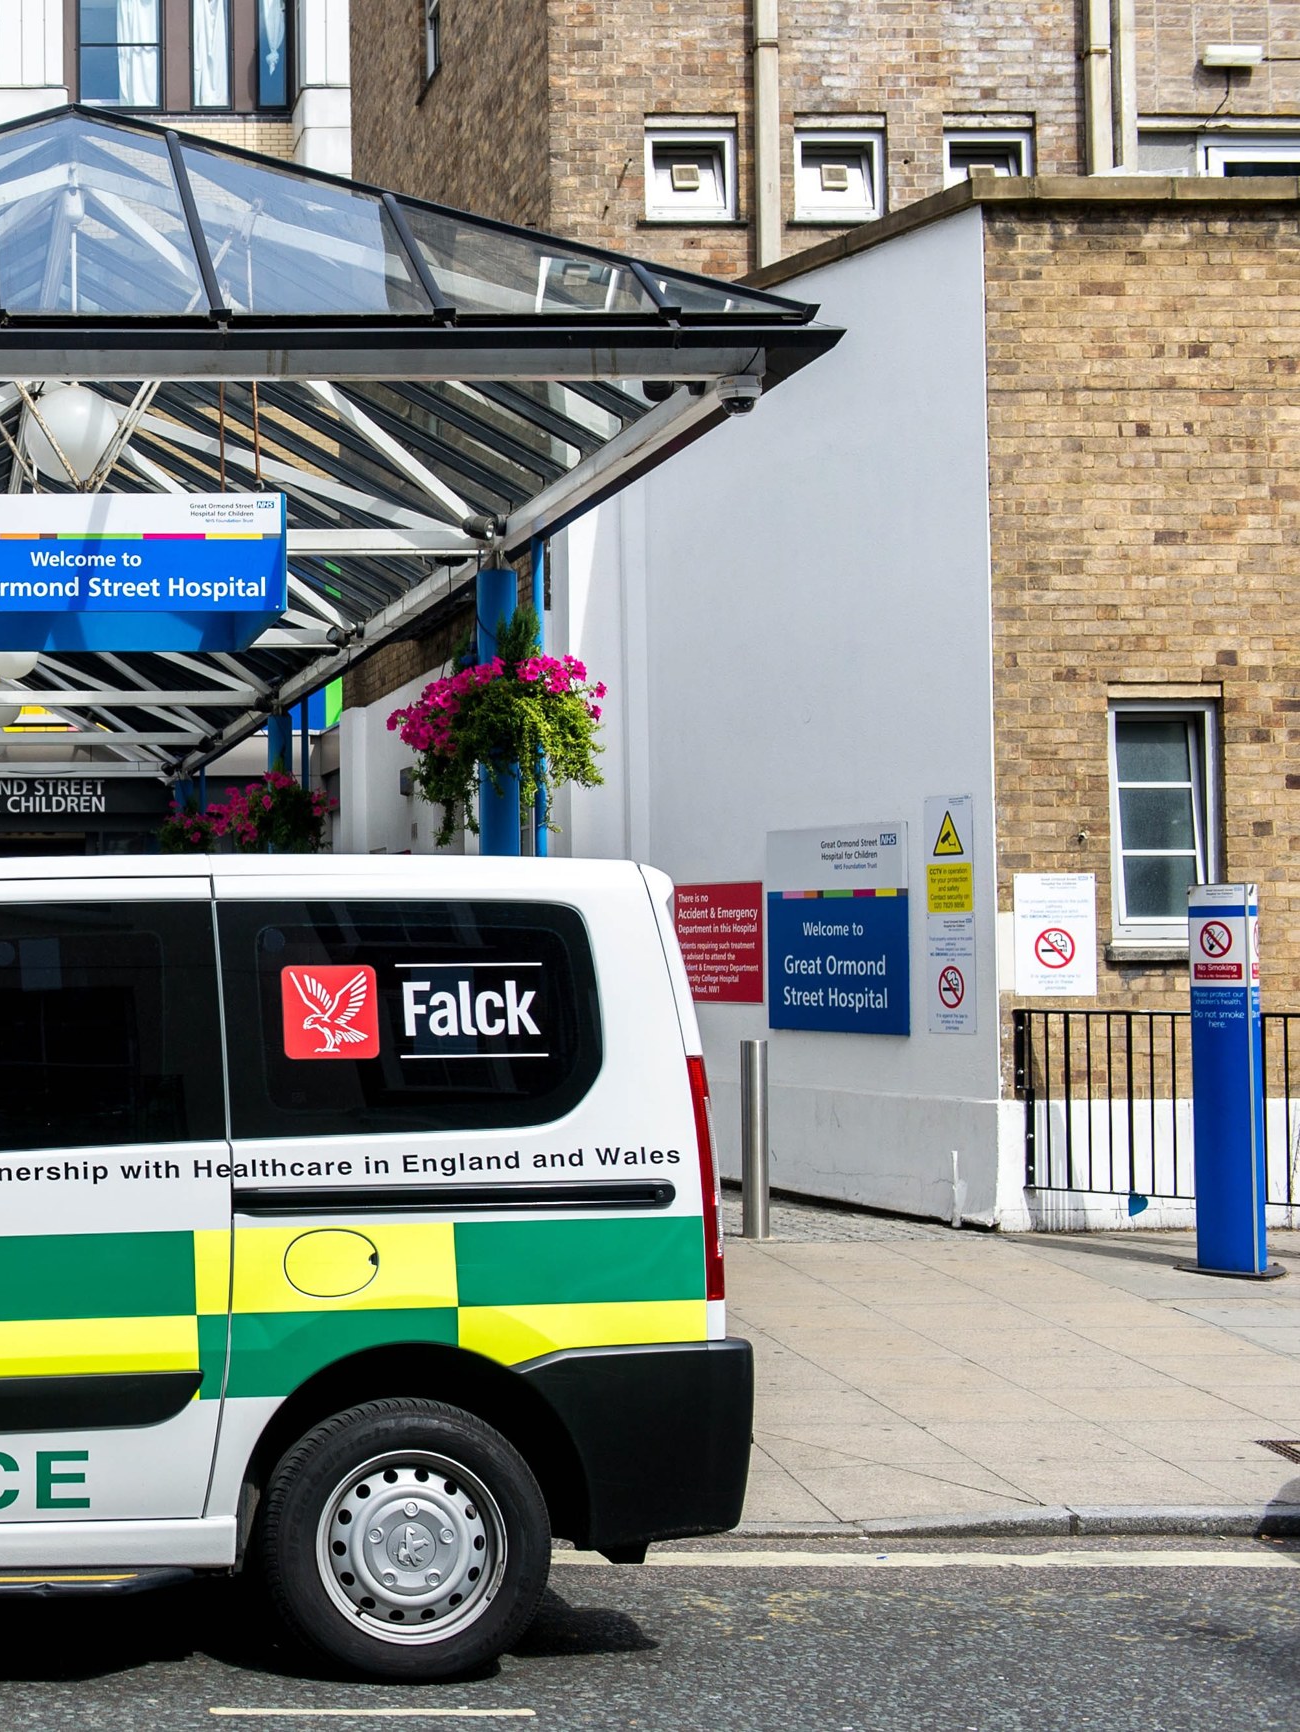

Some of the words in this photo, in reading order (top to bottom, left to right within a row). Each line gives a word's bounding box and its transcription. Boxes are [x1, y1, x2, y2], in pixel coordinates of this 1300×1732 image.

[30, 551, 116, 568] Welcome
[121, 552, 142, 568] to
[88, 577, 159, 598] Street
[169, 577, 266, 602] Hospital
[34, 779, 105, 796] STREET
[6, 796, 106, 813] CHILDREN
[821, 840, 836, 849] Great
[836, 839, 860, 848] Ormond
[861, 838, 878, 847] Street
[880, 833, 896, 845] NHS
[821, 852, 844, 862] Hospital
[844, 851, 853, 860] for
[854, 850, 878, 859] Children
[678, 893, 694, 903] There
[695, 893, 699, 903] is
[701, 894, 709, 903] no
[678, 907, 708, 919] Accident
[710, 908, 716, 919] &
[717, 907, 758, 921] Emergency
[678, 924, 712, 935] Department
[713, 923, 719, 933] in
[720, 923, 731, 933] this
[732, 923, 758, 935] Hospital
[802, 921, 850, 936] Welcome
[852, 922, 864, 936] to
[697, 941, 718, 951] requiring
[719, 941, 730, 950] such
[731, 941, 755, 949] treatment
[687, 952, 704, 960] advised
[705, 952, 710, 960] to
[711, 952, 727, 960] attend
[727, 952, 735, 960] the
[703, 963, 729, 973] Emergency
[729, 963, 758, 972] Department
[784, 954, 822, 975] Great
[826, 954, 886, 976] Ormond
[1207, 964, 1237, 973] Smoking
[701, 974, 718, 983] College
[719, 974, 739, 983] Hospital
[694, 985, 708, 994] Road,
[708, 985, 720, 993] NW1
[1209, 991, 1231, 999] protect
[783, 986, 824, 1007] Street
[828, 987, 888, 1014] Hospital
[402, 980, 541, 1036] Falck
[1194, 1010, 1203, 1018] Do
[1219, 1010, 1245, 1018] smoke
[1208, 1019, 1227, 1028] here.
[120, 1160, 180, 1180] with
[193, 1157, 352, 1179] Healthcare
[364, 1155, 389, 1175] in
[402, 1151, 520, 1176] England
[532, 1148, 584, 1168] and
[596, 1146, 681, 1166] Wales
